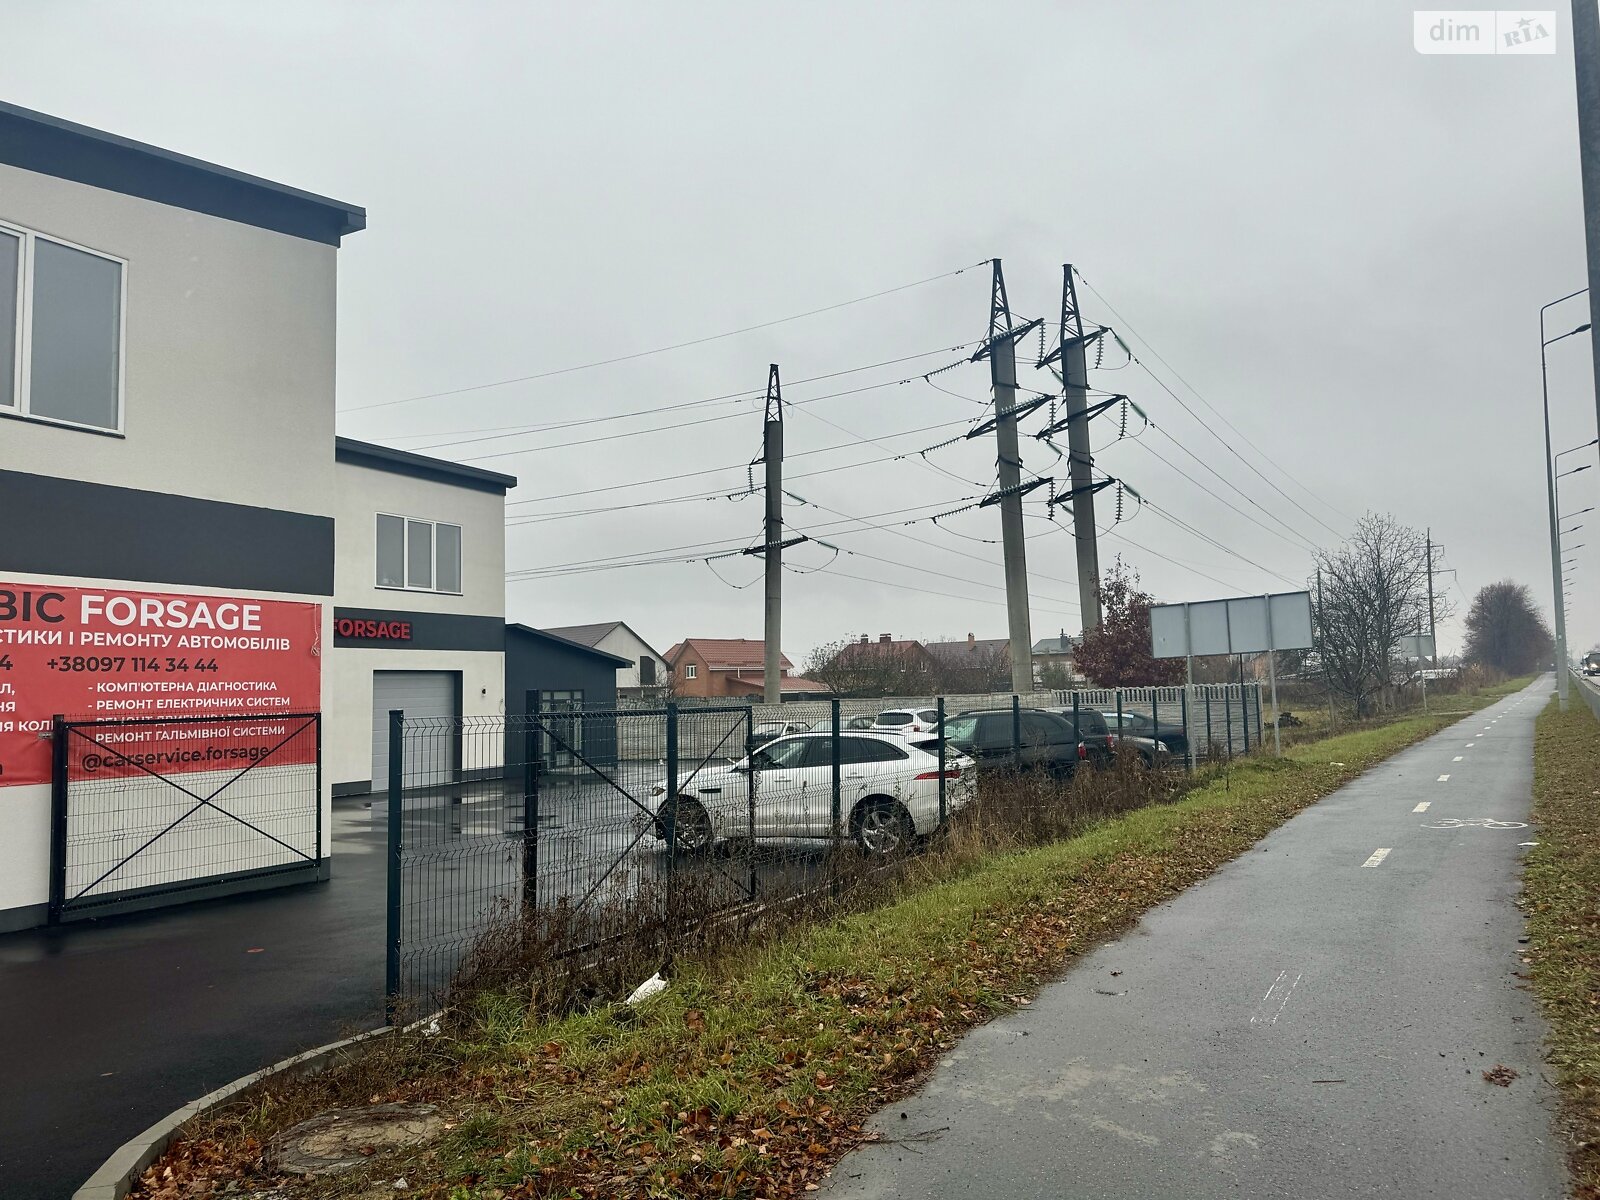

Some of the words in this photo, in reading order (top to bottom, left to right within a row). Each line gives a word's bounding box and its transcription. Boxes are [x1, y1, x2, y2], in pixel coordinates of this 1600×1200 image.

[80, 594, 262, 632] FORSAGE
[0, 629, 62, 645] ТИКИ
[80, 631, 173, 648] РЕМОНТУ
[177, 634, 290, 651] АВТОМОБІЛІВ
[47, 655, 126, 673] +38097
[131, 657, 160, 672] 114
[165, 657, 189, 672] 34
[194, 658, 218, 672] 44
[97, 682, 194, 693] КОМП'ЮТЕРНА
[197, 681, 277, 693] ДІАГНОСТИКА
[96, 699, 153, 710] РЕМОНТ
[156, 697, 244, 709] ЕЛЕКТРИЧНИХ
[246, 697, 290, 707] СИСТЕМ
[95, 731, 153, 743] РЕМОНТ
[155, 726, 231, 741] ГАЛЬМІВНОЇ
[232, 726, 286, 737] СИСТЕМИ
[82, 746, 270, 773] @carservice.forsage
